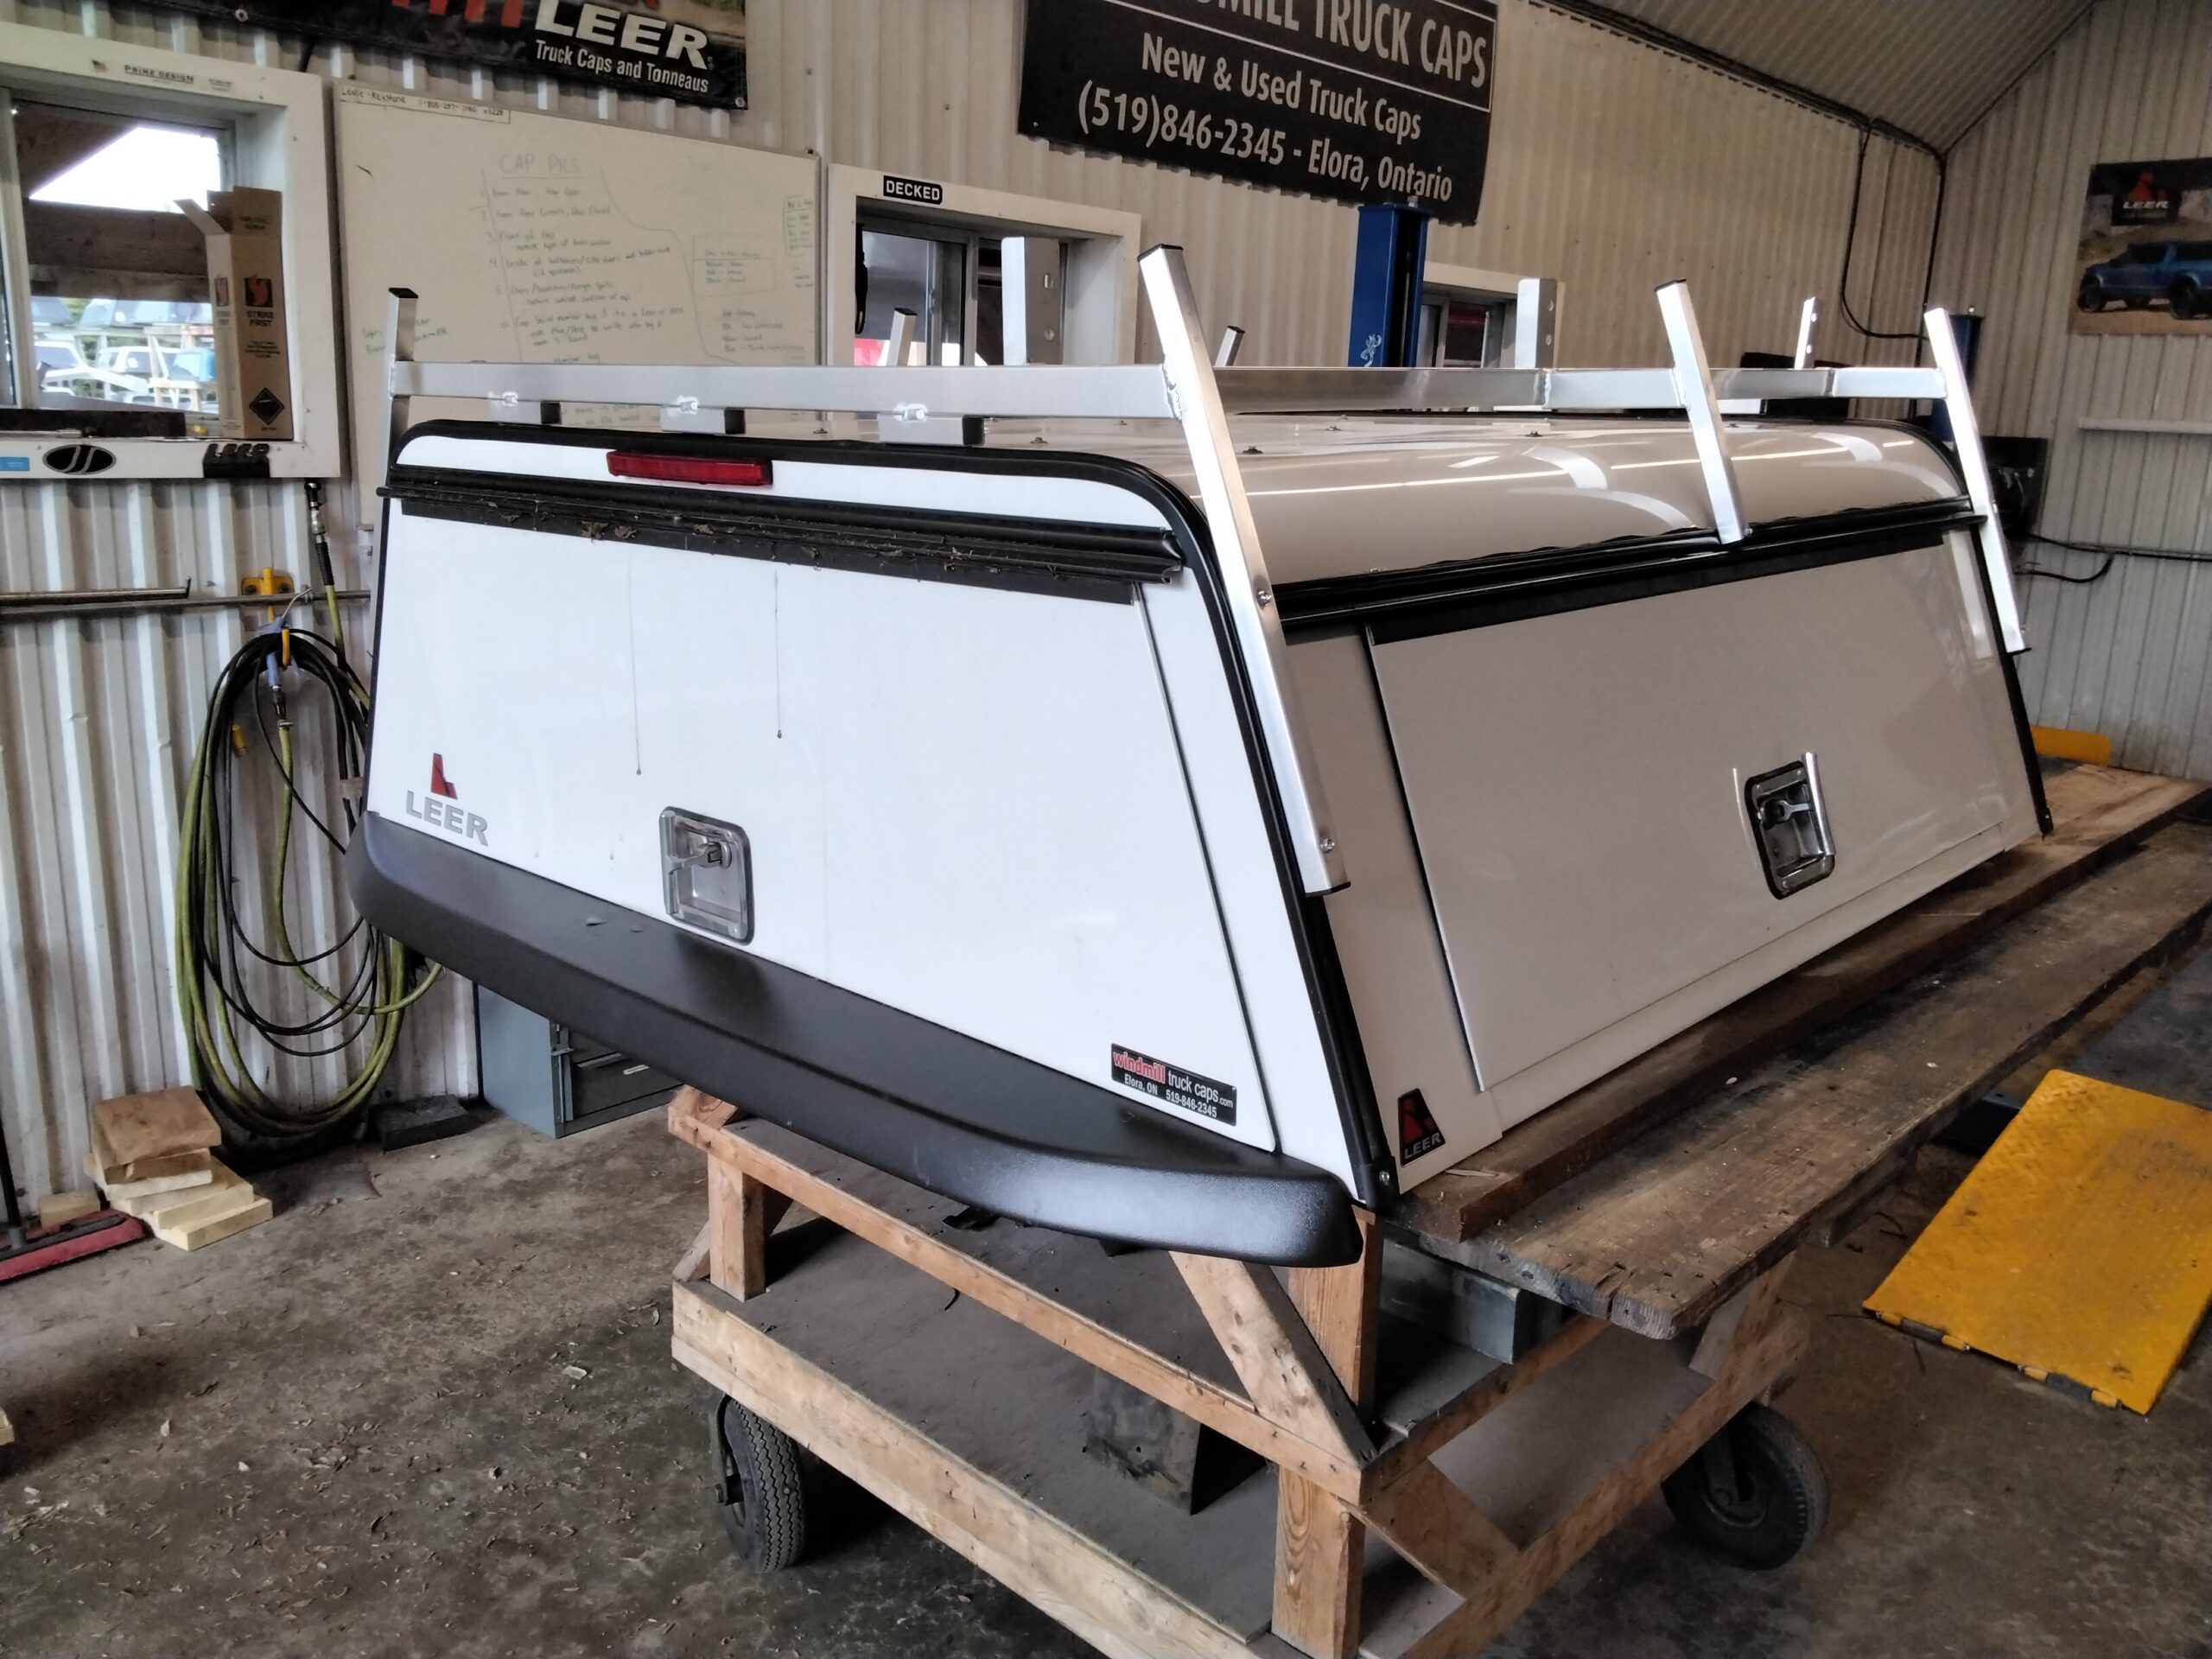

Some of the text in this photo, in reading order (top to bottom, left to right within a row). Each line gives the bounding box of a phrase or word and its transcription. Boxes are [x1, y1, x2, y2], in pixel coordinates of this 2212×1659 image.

[535, 0, 709, 69] LEER
[1314, 0, 1412, 66] TRUCK
[1420, 19, 1487, 88] CAPS
[124, 65, 155, 77] PRIME
[159, 71, 194, 84] DESIGN
[536, 39, 709, 93] Truck Caps and Tonneaus
[1141, 32, 1422, 145] New & Used Truck Caps
[1078, 79, 1287, 166] (519)846-2345
[1307, 137, 1370, 192] Elora,
[1377, 156, 1452, 201] Ontario
[499, 153, 582, 175] CAP PICS
[886, 180, 940, 201] DECKED
[202, 443, 270, 467] LEER
[406, 790, 489, 847] LEER
[1112, 1051, 1166, 1084] windmill
[1168, 1070, 1192, 1093] truck
[1124, 1073, 1218, 1118] Elora, ON 519-846-2345
[1404, 1132, 1442, 1160] LEER
